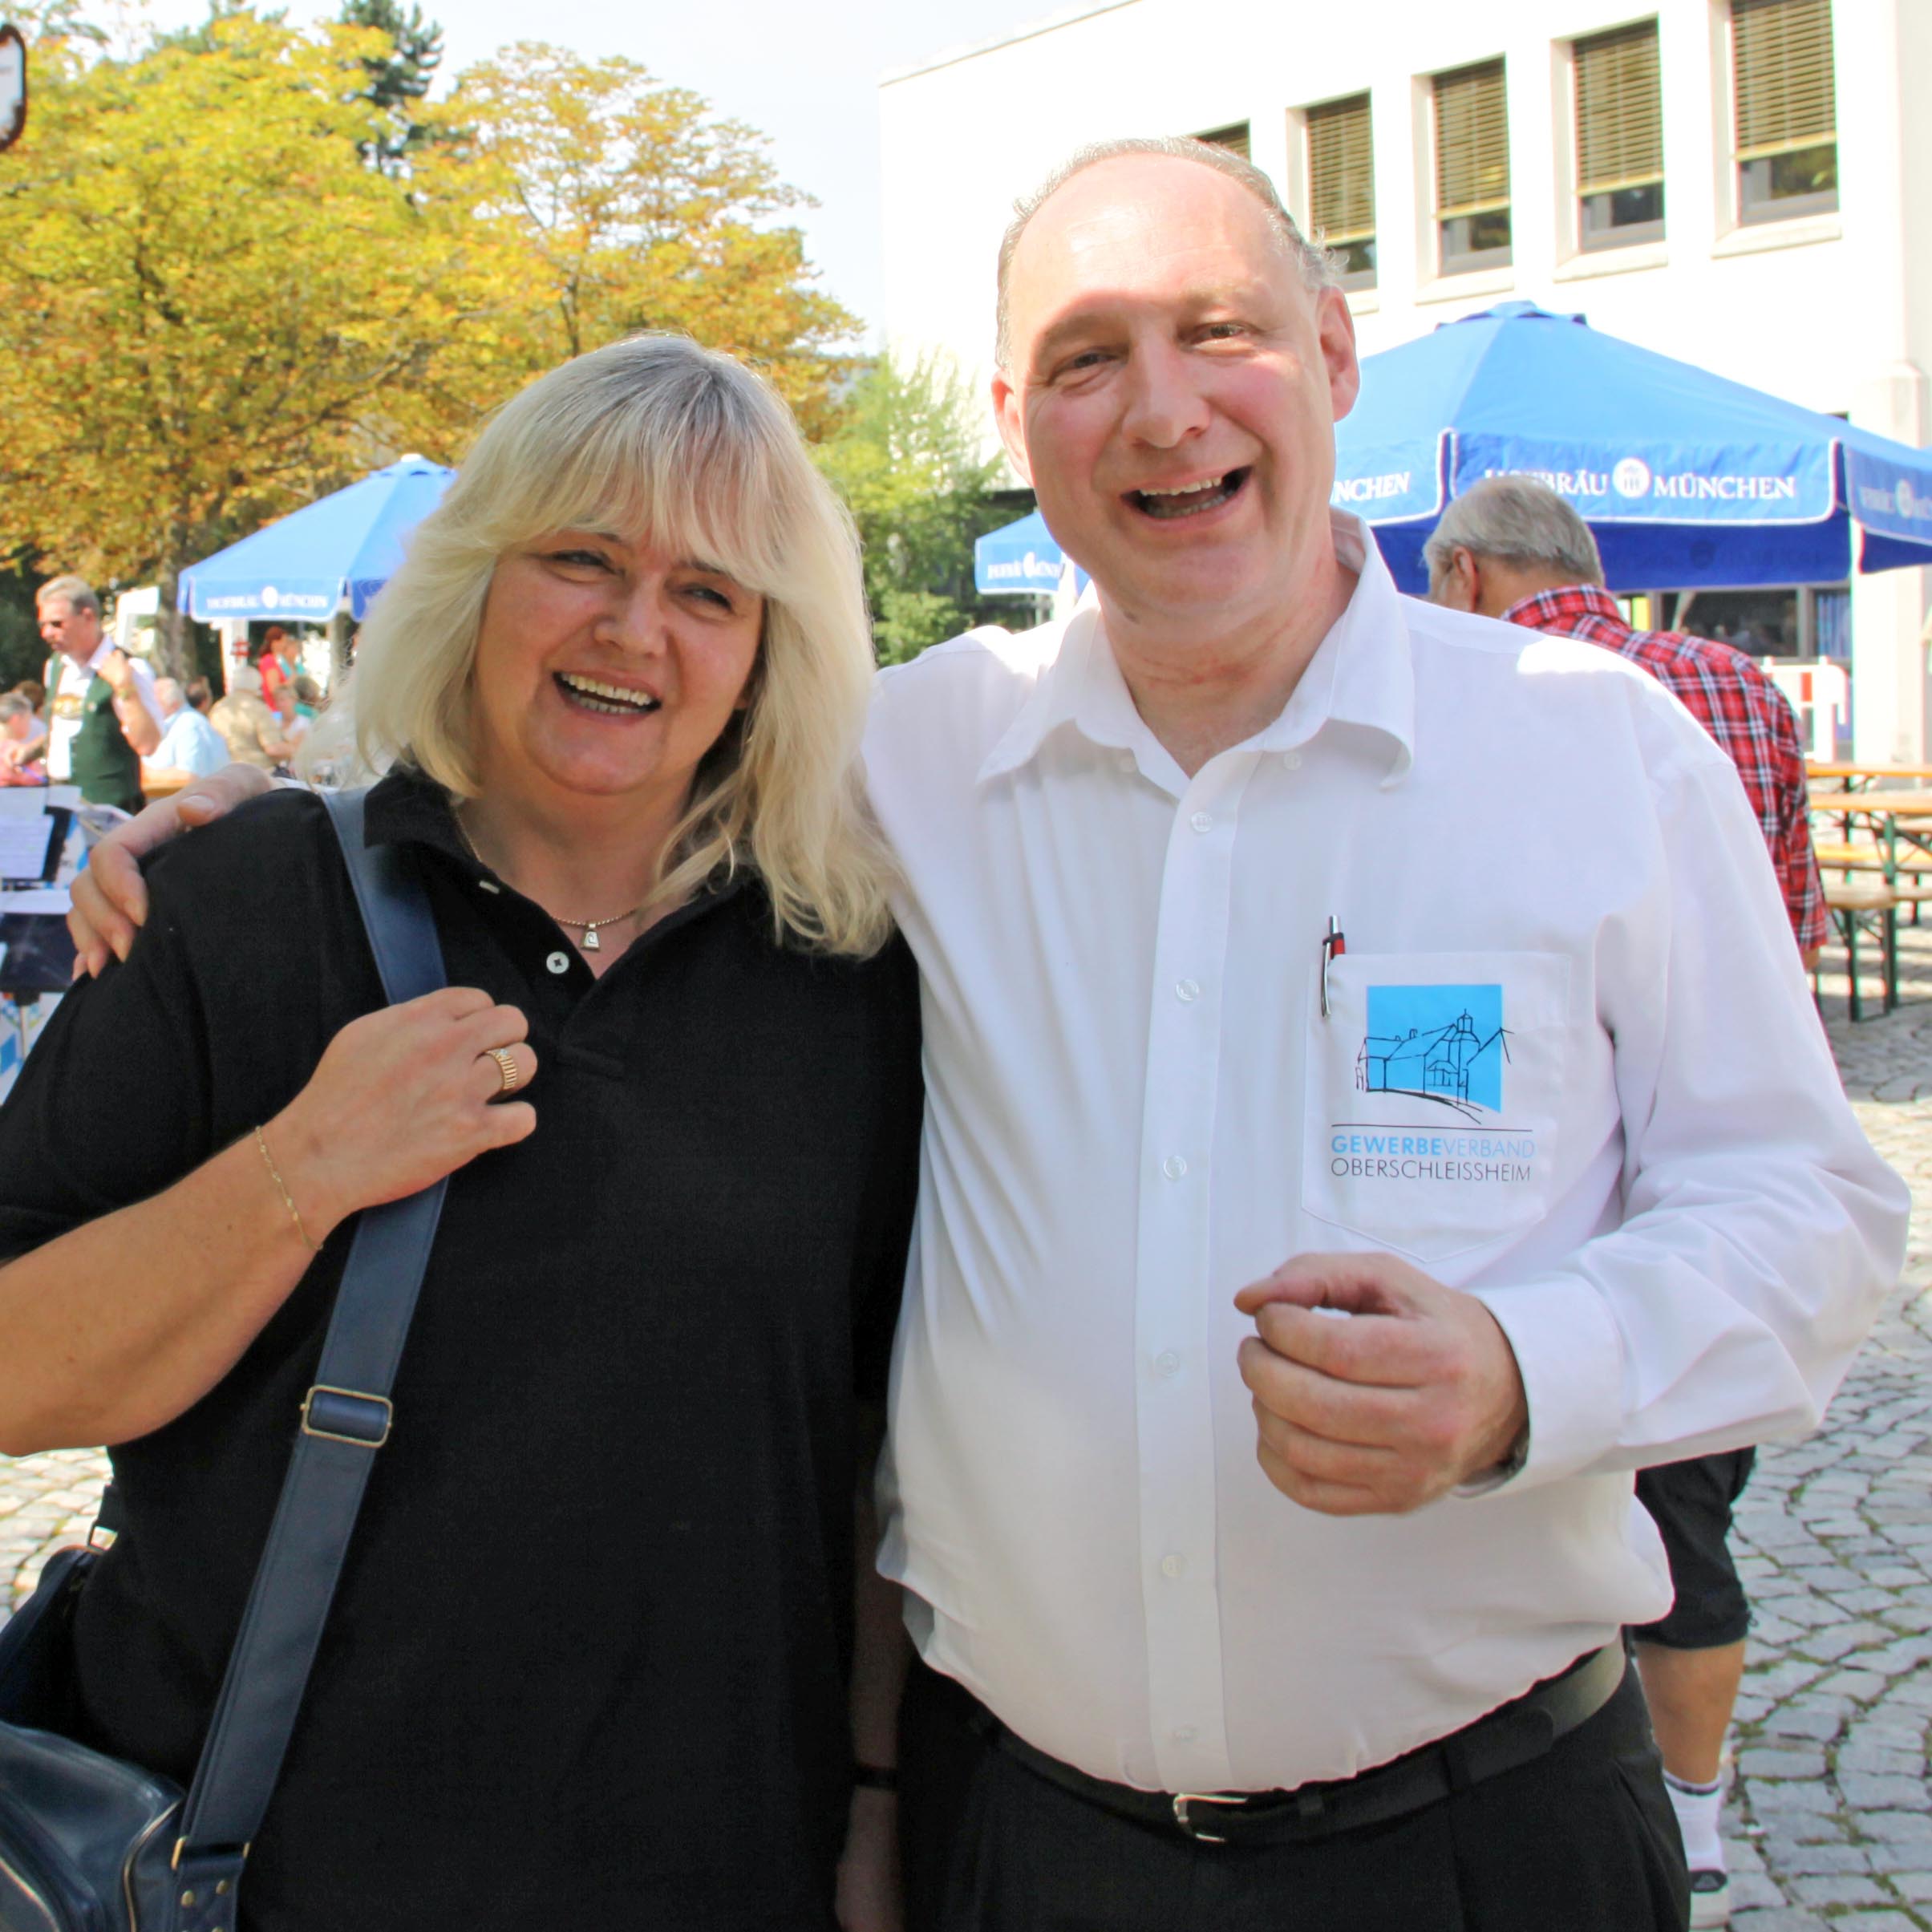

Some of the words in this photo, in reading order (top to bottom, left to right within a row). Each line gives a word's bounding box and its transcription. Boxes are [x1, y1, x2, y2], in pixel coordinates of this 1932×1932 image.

[1332, 471, 1411, 504] NCHEN
[1484, 468, 1609, 496] BRÄU
[1654, 472, 1796, 500] MÜNCHEN
[1331, 1135, 1536, 1159] GEWERBEVERBAND
[1331, 1157, 1531, 1181] OBERSCHLEISSHEIM
